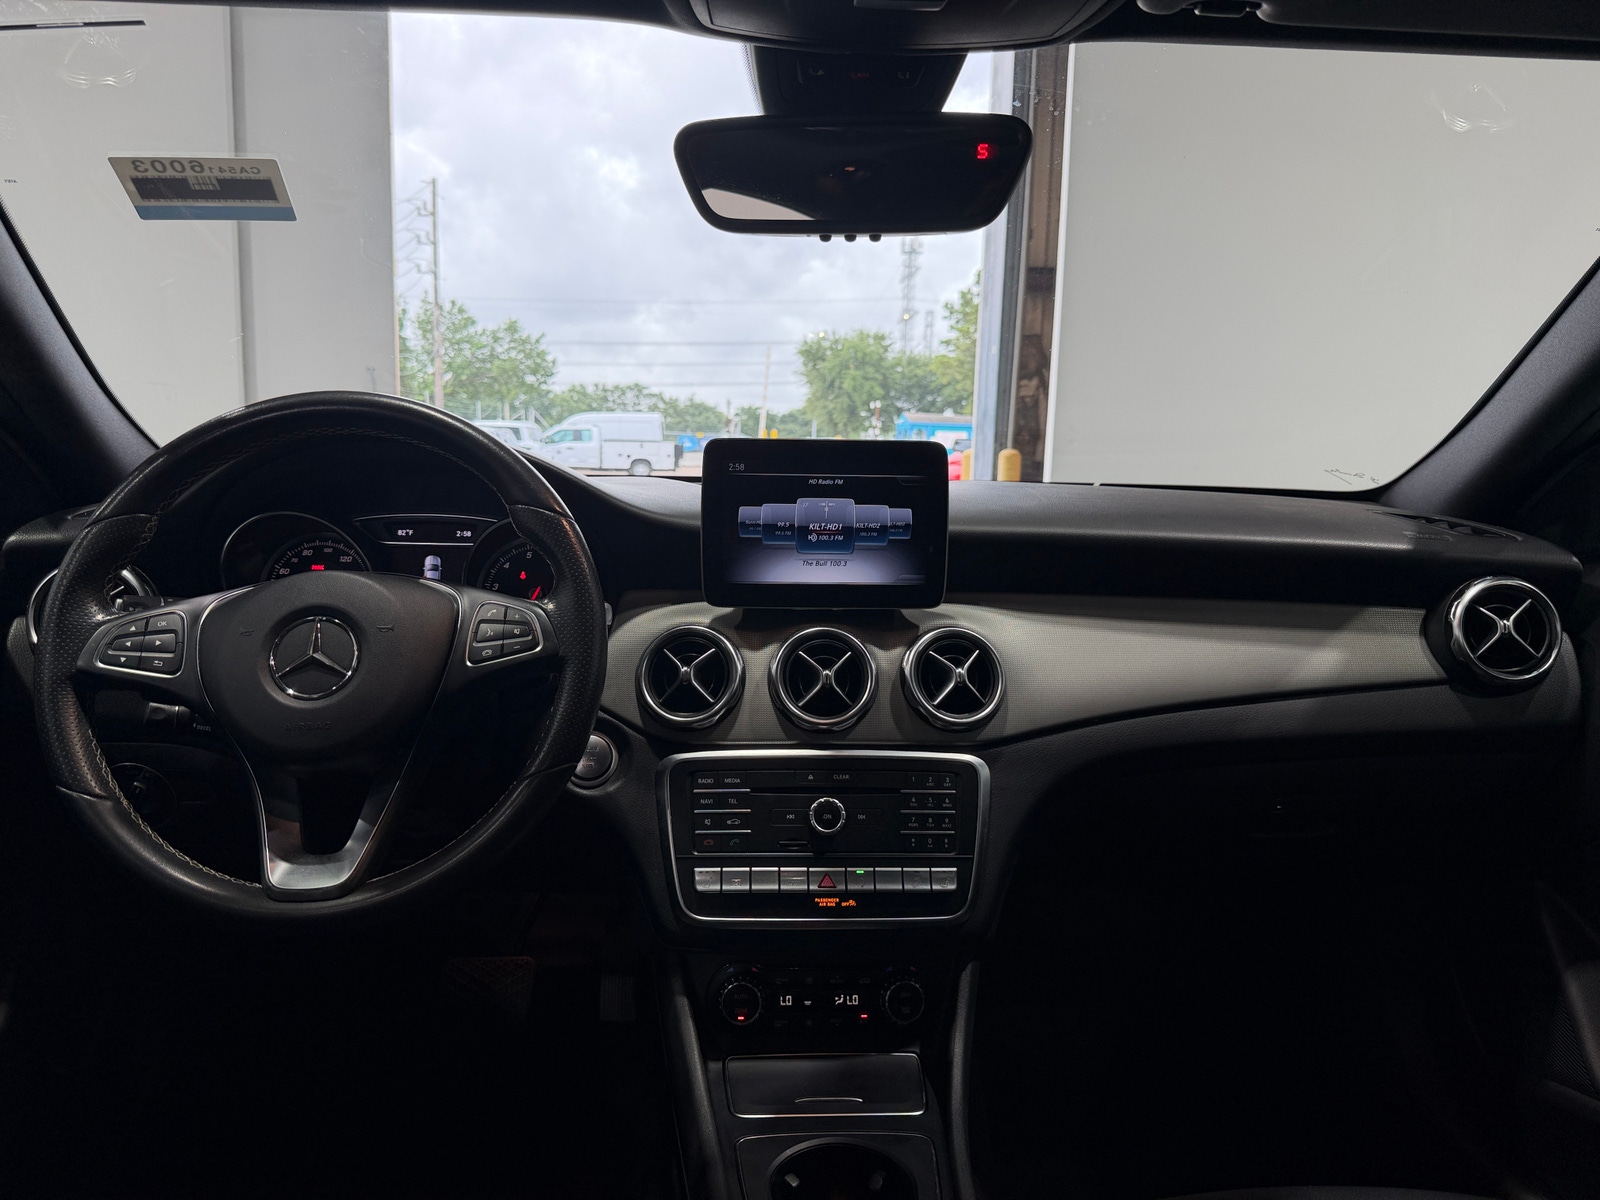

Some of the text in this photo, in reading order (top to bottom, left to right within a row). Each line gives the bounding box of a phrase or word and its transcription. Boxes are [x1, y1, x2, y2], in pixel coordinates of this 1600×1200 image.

[728, 463, 745, 471] 2:58
[808, 523, 843, 531] KILT-HD1
[397, 528, 414, 536] 82°F
[339, 555, 353, 563] 120
[526, 551, 533, 559] 5
[491, 582, 500, 591] 3
